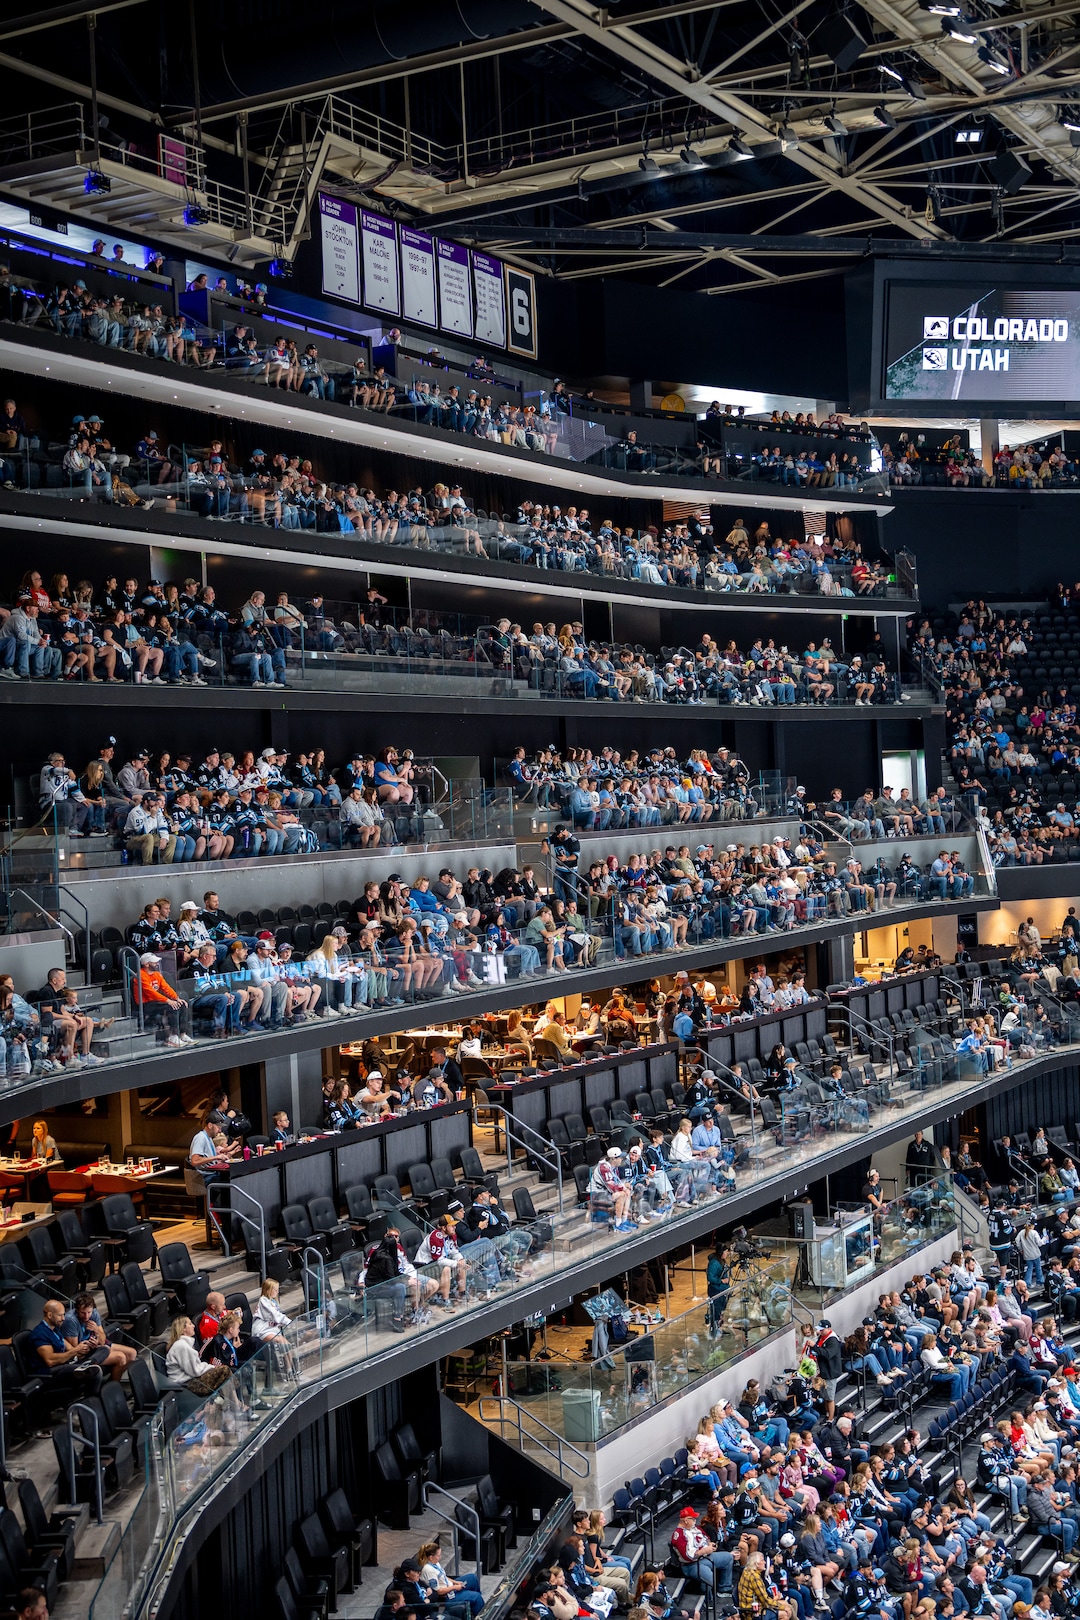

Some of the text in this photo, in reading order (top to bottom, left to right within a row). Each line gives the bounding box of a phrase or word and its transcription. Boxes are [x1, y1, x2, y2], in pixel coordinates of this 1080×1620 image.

[31, 215, 42, 226] 600
[331, 224, 347, 235] JOHN
[325, 230, 353, 247] STOCKTON
[372, 238, 386, 249] KARL
[369, 246, 390, 260] MALONE
[512, 287, 530, 336] 6
[953, 317, 1068, 342] COLORADO
[952, 348, 1010, 371] UTAH
[695, 1092, 701, 1100] 9
[430, 1245, 442, 1255] 92
[850, 1498, 860, 1509] 70
[857, 1586, 864, 1596] 9
